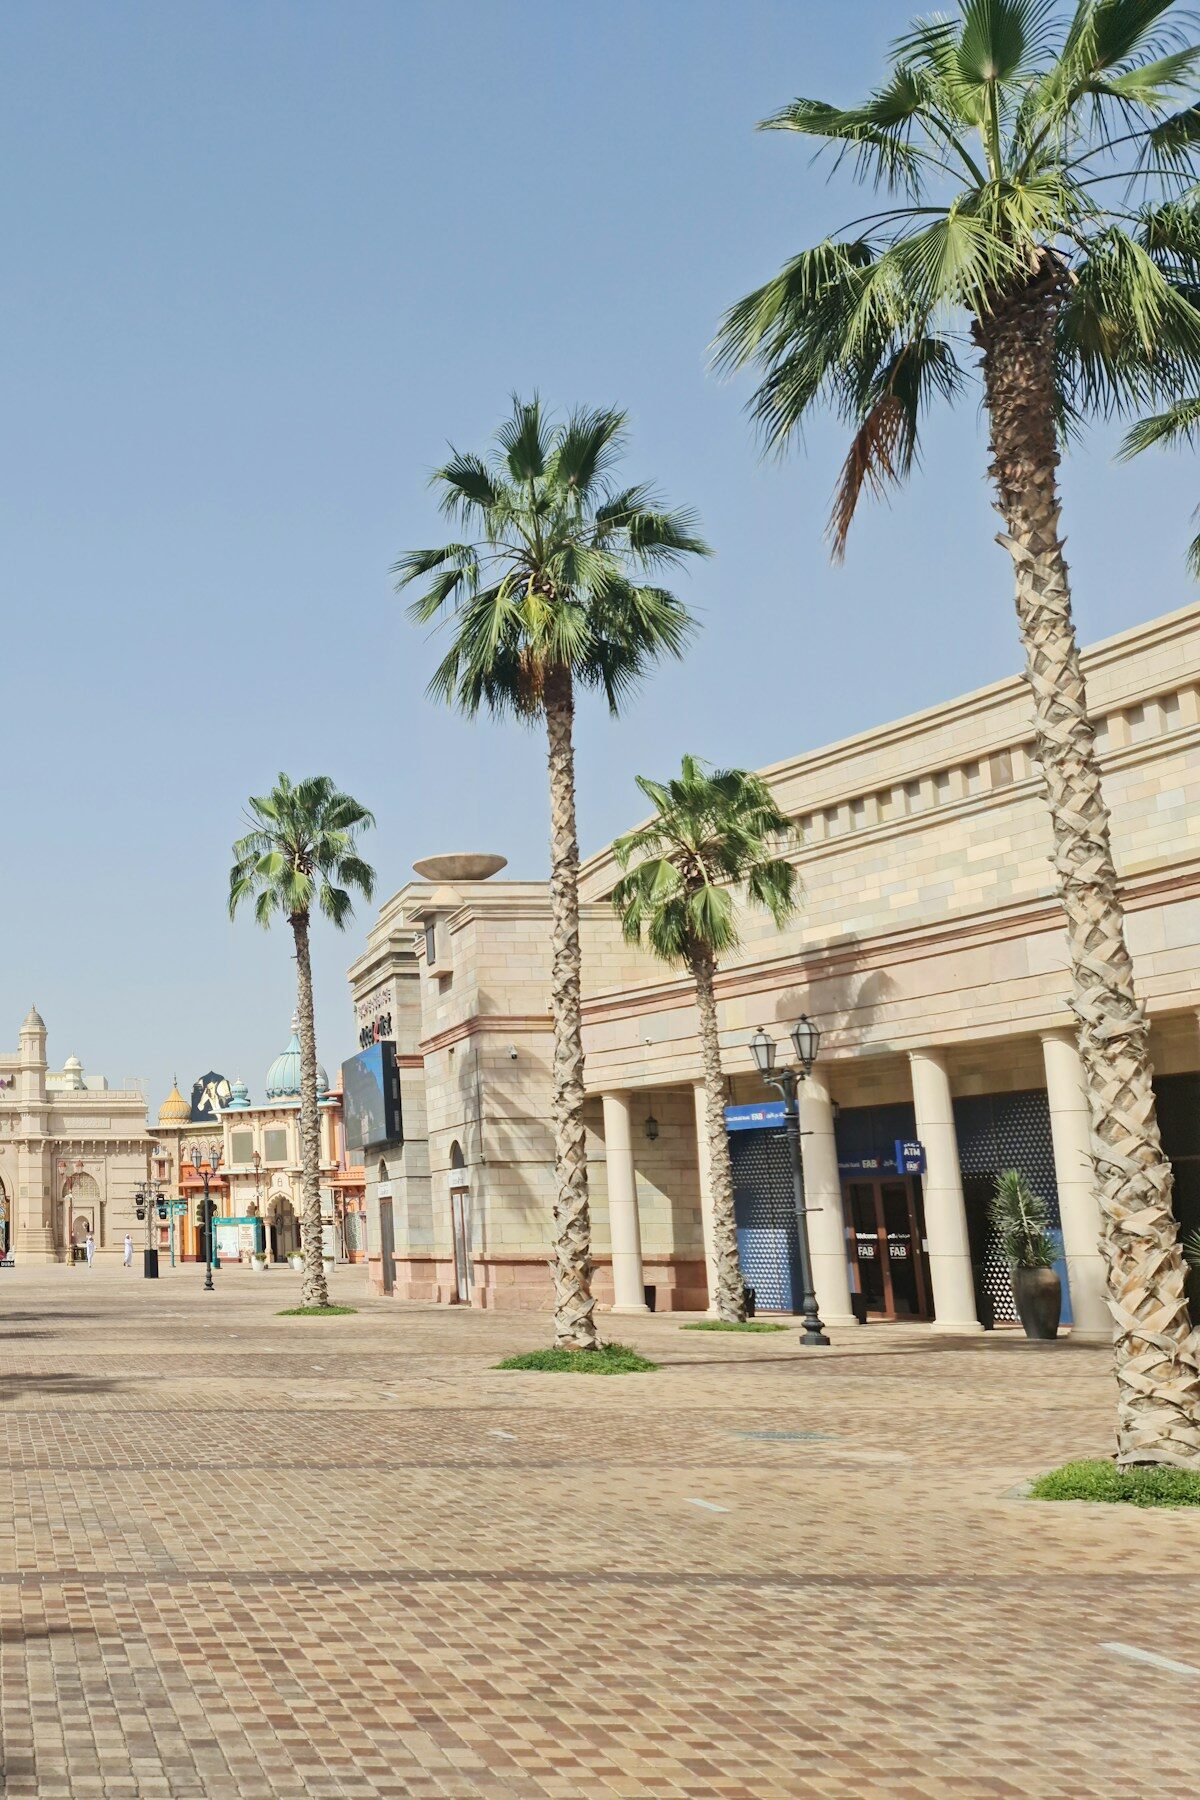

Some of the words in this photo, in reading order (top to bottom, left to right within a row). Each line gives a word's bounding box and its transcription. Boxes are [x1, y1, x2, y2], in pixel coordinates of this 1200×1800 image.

[904, 1148, 921, 1156] ATM
[862, 1160, 877, 1168] FAB
[857, 1246, 875, 1256] FAB
[889, 1246, 907, 1257] FAB
